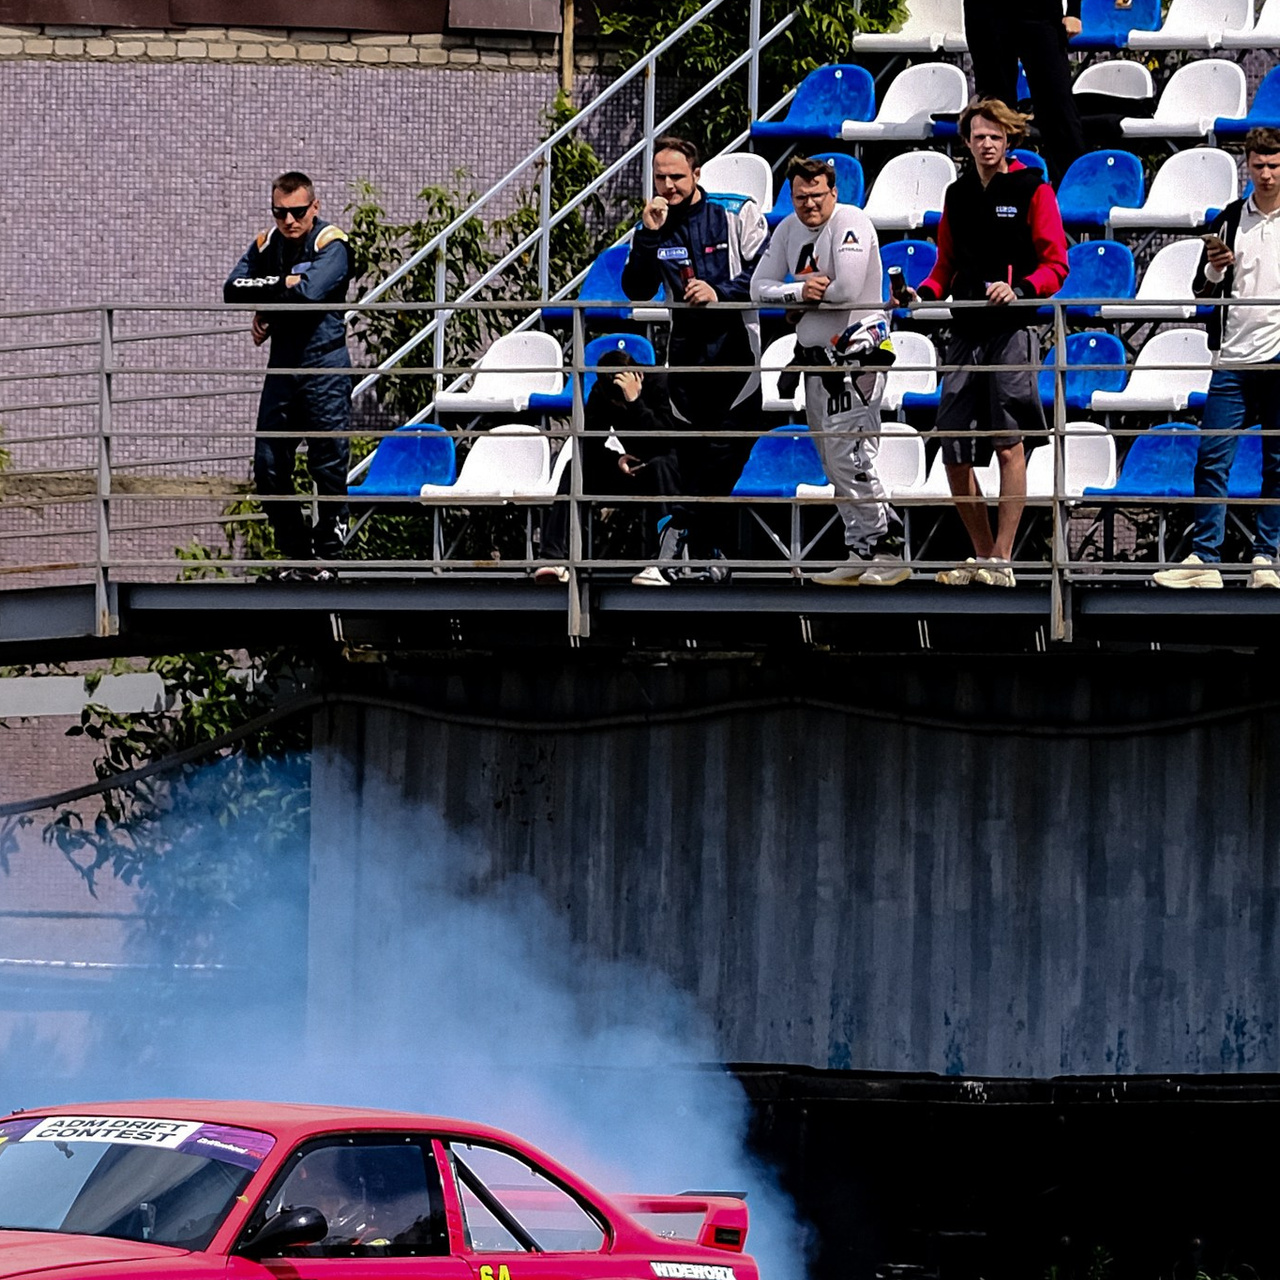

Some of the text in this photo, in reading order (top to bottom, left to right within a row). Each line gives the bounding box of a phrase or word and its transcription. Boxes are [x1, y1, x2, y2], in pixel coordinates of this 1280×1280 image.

[48, 1119, 188, 1132] ADM DRIFT
[36, 1128, 177, 1142] CONTEST
